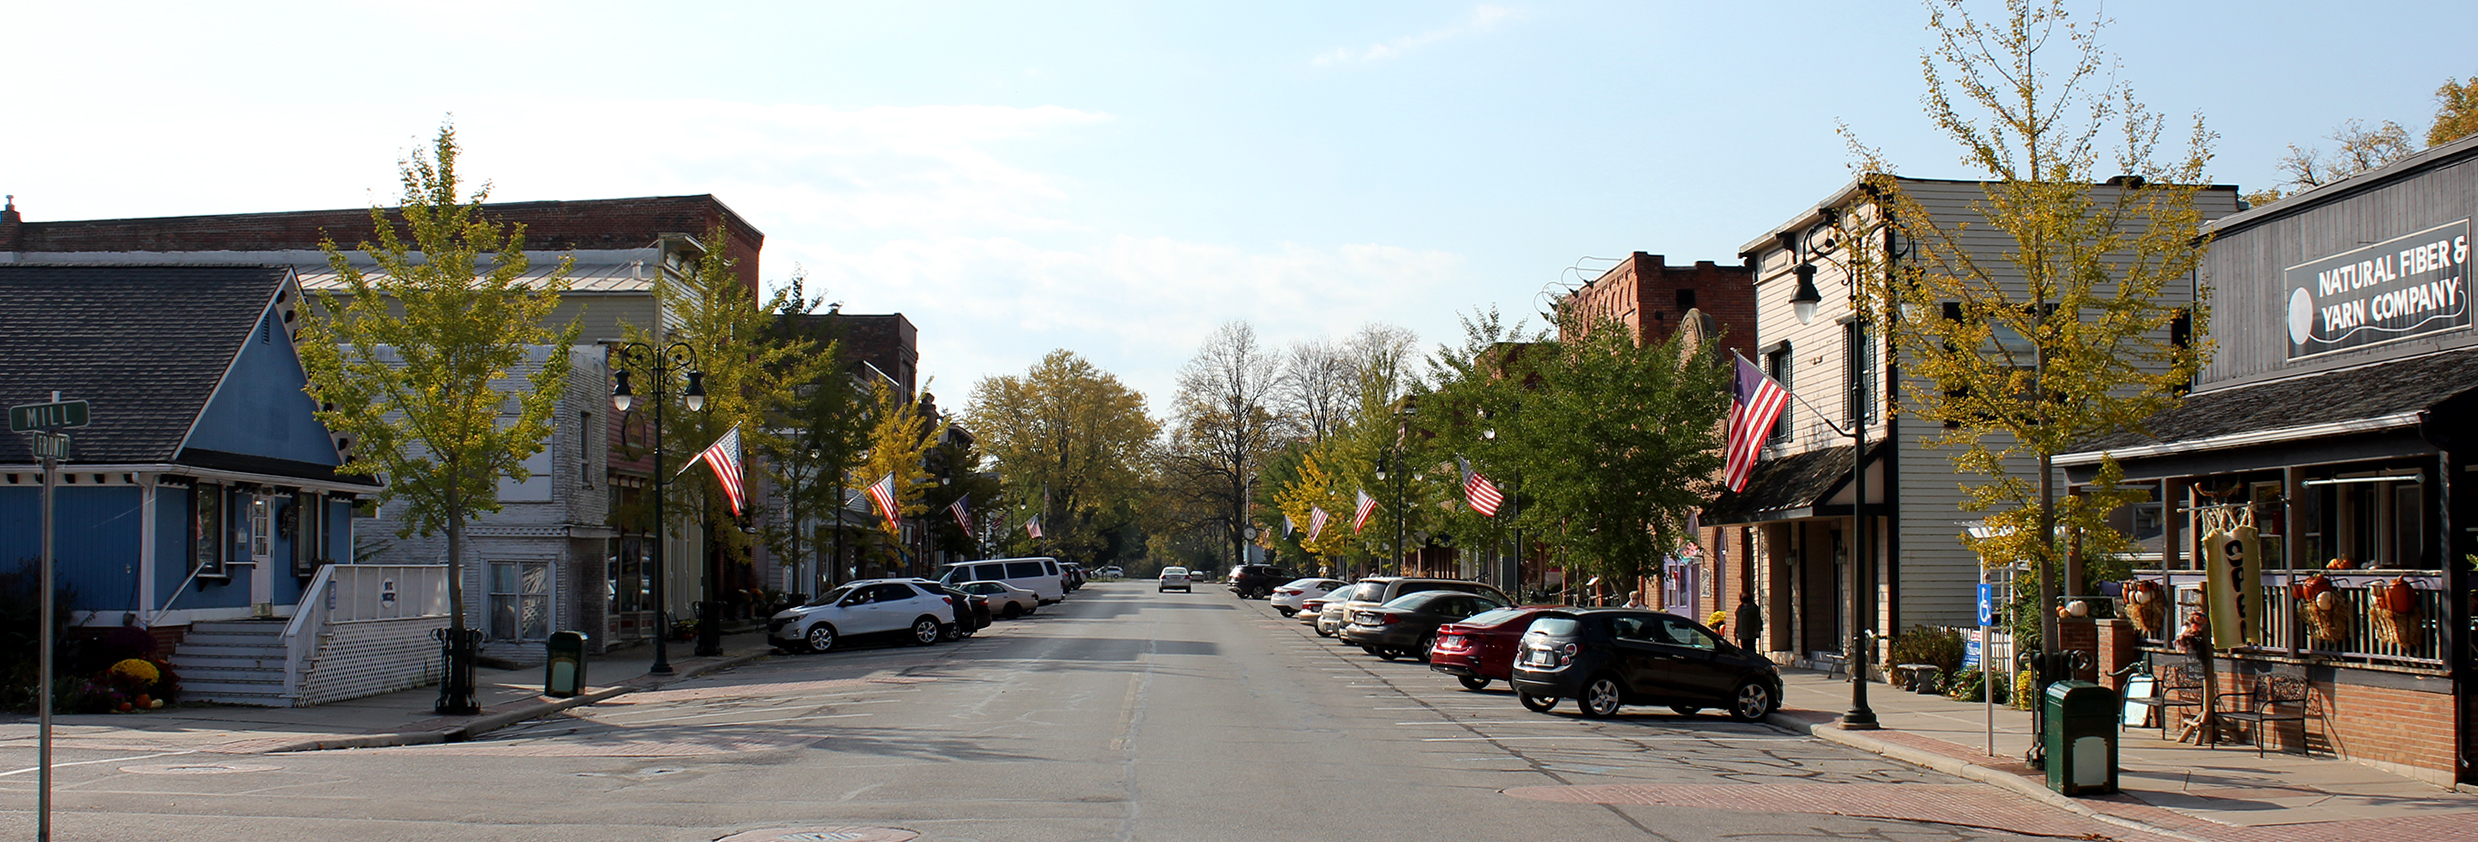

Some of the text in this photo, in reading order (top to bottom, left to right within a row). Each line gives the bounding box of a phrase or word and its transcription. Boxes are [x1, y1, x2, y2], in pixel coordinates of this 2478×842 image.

[2318, 235, 2468, 298] NATURAL FIBER &
[2321, 276, 2459, 332] YARN COMPANY
[26, 405, 72, 428] MILL
[38, 435, 66, 457] FRONT
